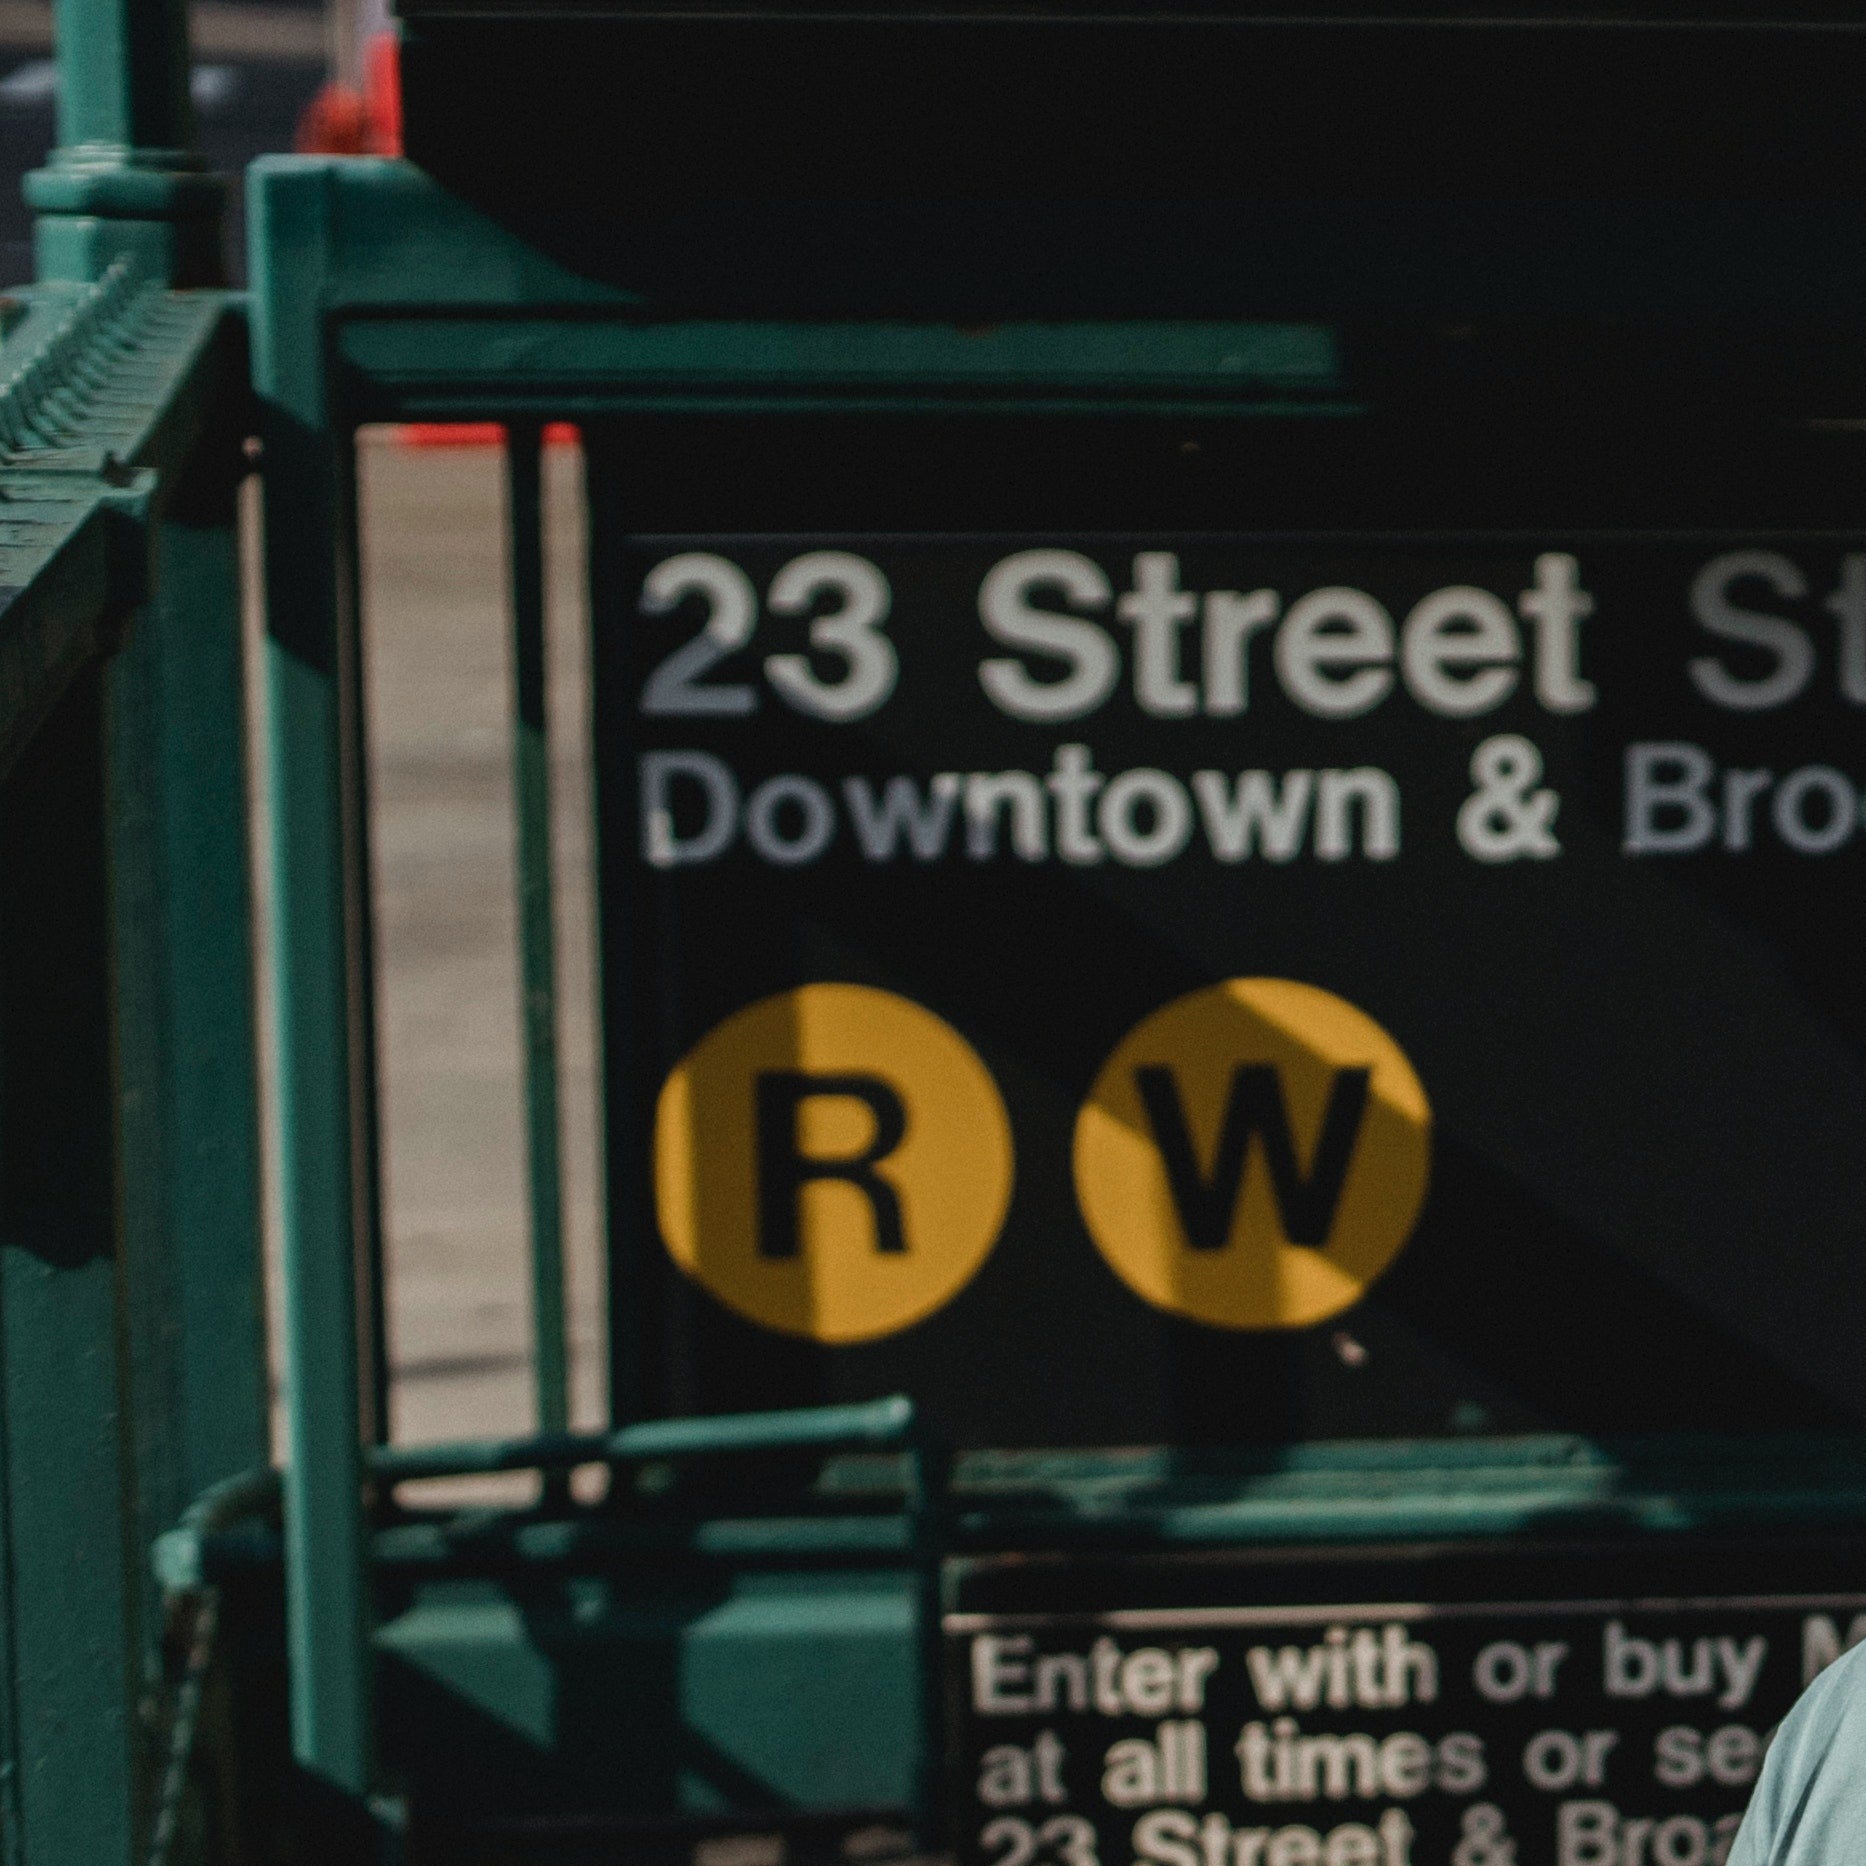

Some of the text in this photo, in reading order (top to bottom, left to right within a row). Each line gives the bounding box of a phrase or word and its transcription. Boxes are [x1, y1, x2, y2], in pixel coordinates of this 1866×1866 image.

[643, 550, 898, 721] 23
[978, 548, 1594, 718] Street
[642, 750, 1400, 866] Downtown
[1455, 734, 1561, 863] &
[752, 1060, 1376, 1260] R W
[970, 1632, 1219, 1714] Enter
[1244, 1622, 1438, 1712] with
[1471, 1638, 1568, 1704] or
[1602, 1619, 1767, 1710] buy
[978, 1716, 1773, 1807] at all times or se
